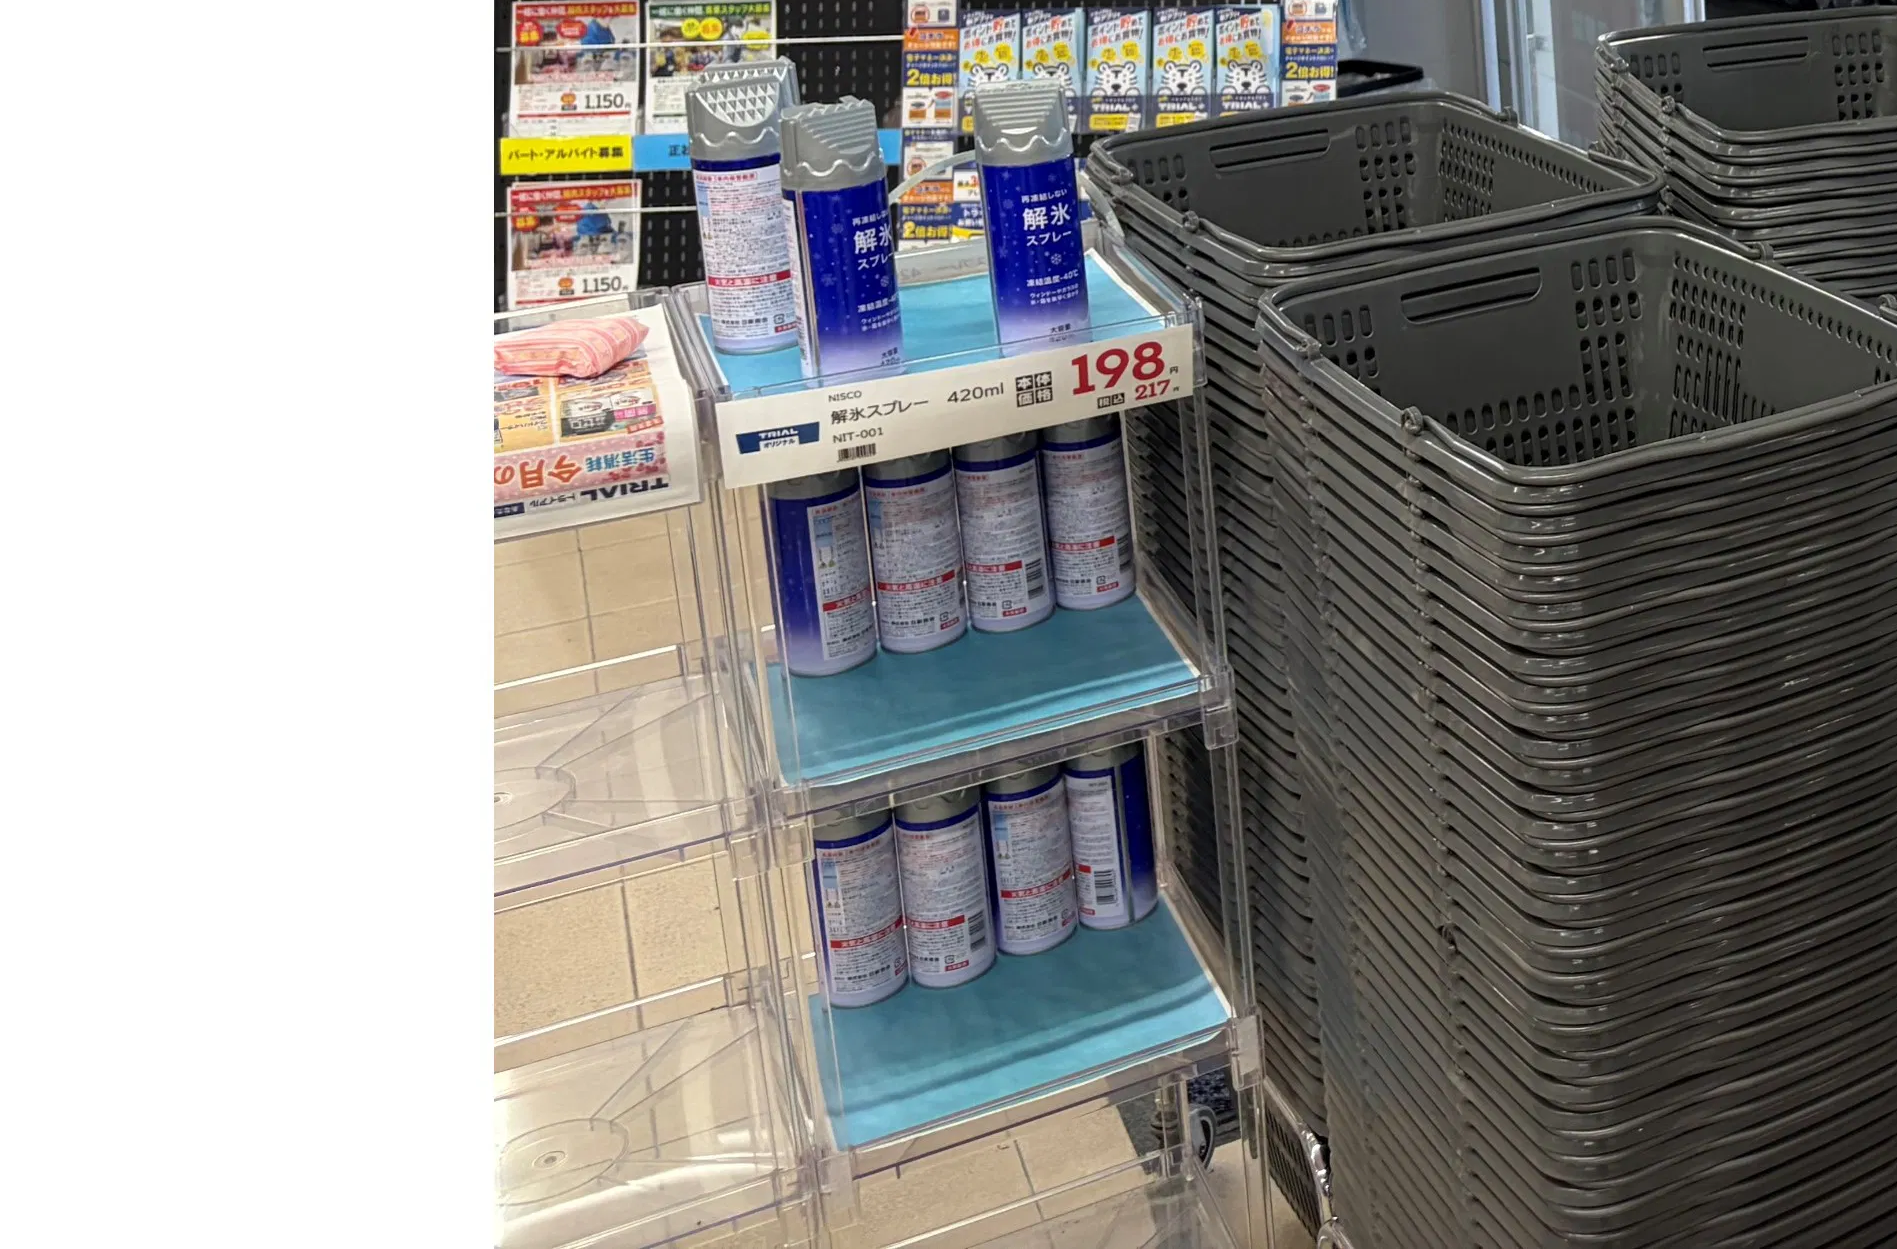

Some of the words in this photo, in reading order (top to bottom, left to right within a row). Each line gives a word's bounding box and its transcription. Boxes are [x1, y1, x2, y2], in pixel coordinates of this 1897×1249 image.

[508, 147, 624, 161] パート・アルバイト募集
[1021, 189, 1068, 204] 再凍結しない
[1023, 202, 1071, 231] 解氷
[854, 223, 893, 255] 解氷
[1026, 230, 1072, 247] スプレー
[857, 251, 896, 271] スプレー
[828, 391, 862, 402] NISCO
[831, 397, 930, 425] 解氷スプレー
[946, 383, 1005, 405] 420ml
[1097, 392, 1125, 409] 税込
[758, 427, 799, 440] TRIAL
[832, 428, 884, 445] NIT-001
[762, 437, 796, 449] オリジナル
[580, 477, 669, 501] TRIAL
